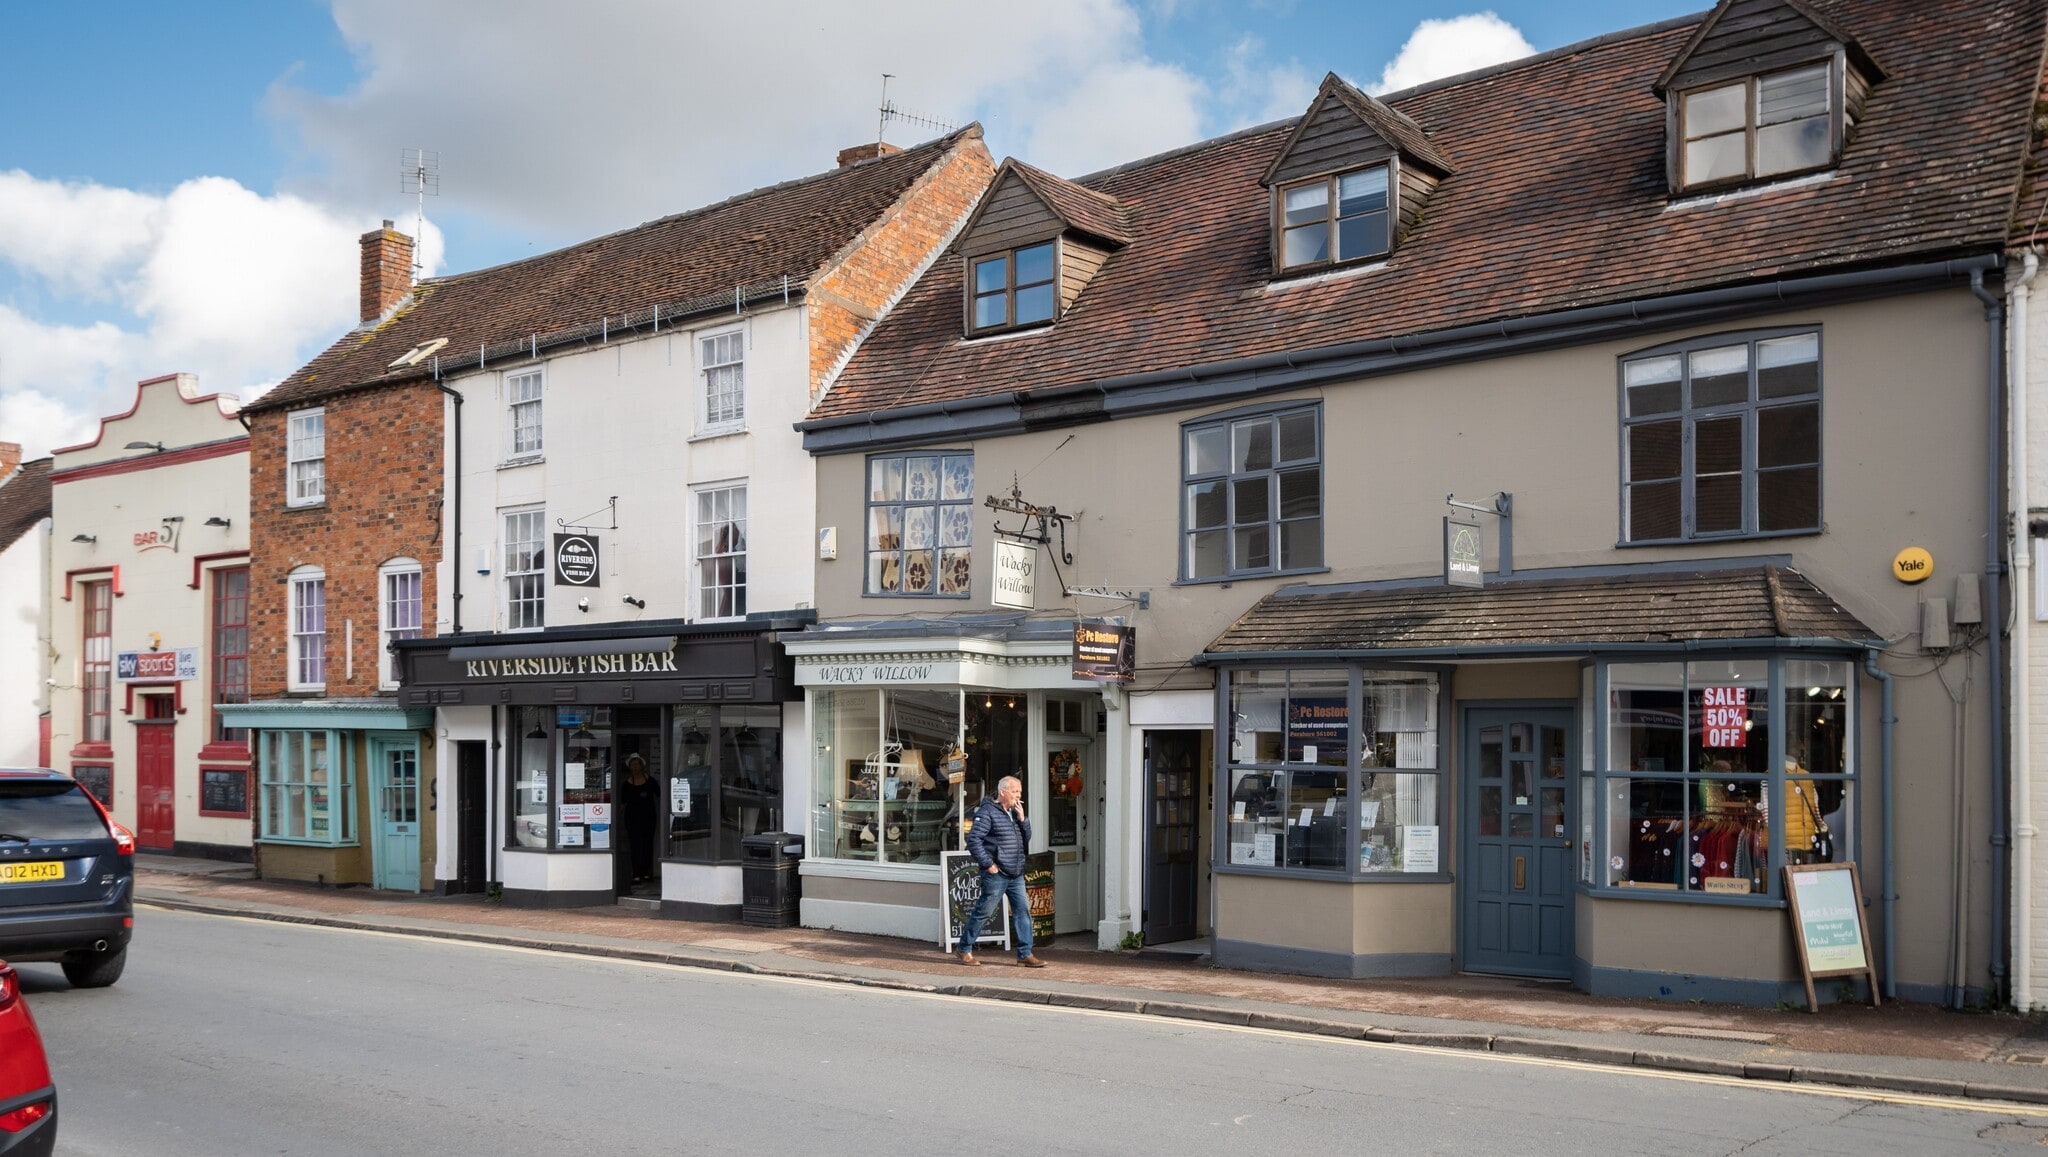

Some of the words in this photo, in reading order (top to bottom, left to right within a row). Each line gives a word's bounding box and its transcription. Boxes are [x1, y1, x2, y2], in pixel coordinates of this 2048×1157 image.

[134, 532, 158, 546] BAR
[160, 517, 184, 553] 57
[561, 554, 593, 564] RIVERSIDE
[1000, 555, 1032, 577] Wacky
[1450, 561, 1461, 571] Land
[1898, 559, 1925, 571] Yale
[998, 577, 1033, 594] Willow
[1086, 630, 1094, 641] Pc
[1094, 631, 1119, 644] Restore
[119, 656, 137, 676] sky
[138, 654, 174, 676] sports
[179, 651, 192, 662] live
[179, 664, 196, 677] here
[466, 657, 574, 677] RIVERSIDE
[577, 654, 626, 674] FISH
[630, 651, 678, 672] BAR
[819, 666, 867, 683] WACKY
[873, 665, 932, 680] WILLOW
[1704, 687, 1746, 706] SALE
[1300, 706, 1312, 718] Pc
[1313, 705, 1350, 718] Restore
[1707, 708, 1743, 727] 50%
[1709, 728, 1740, 747] OFF
[31, 864, 58, 877] HXD
